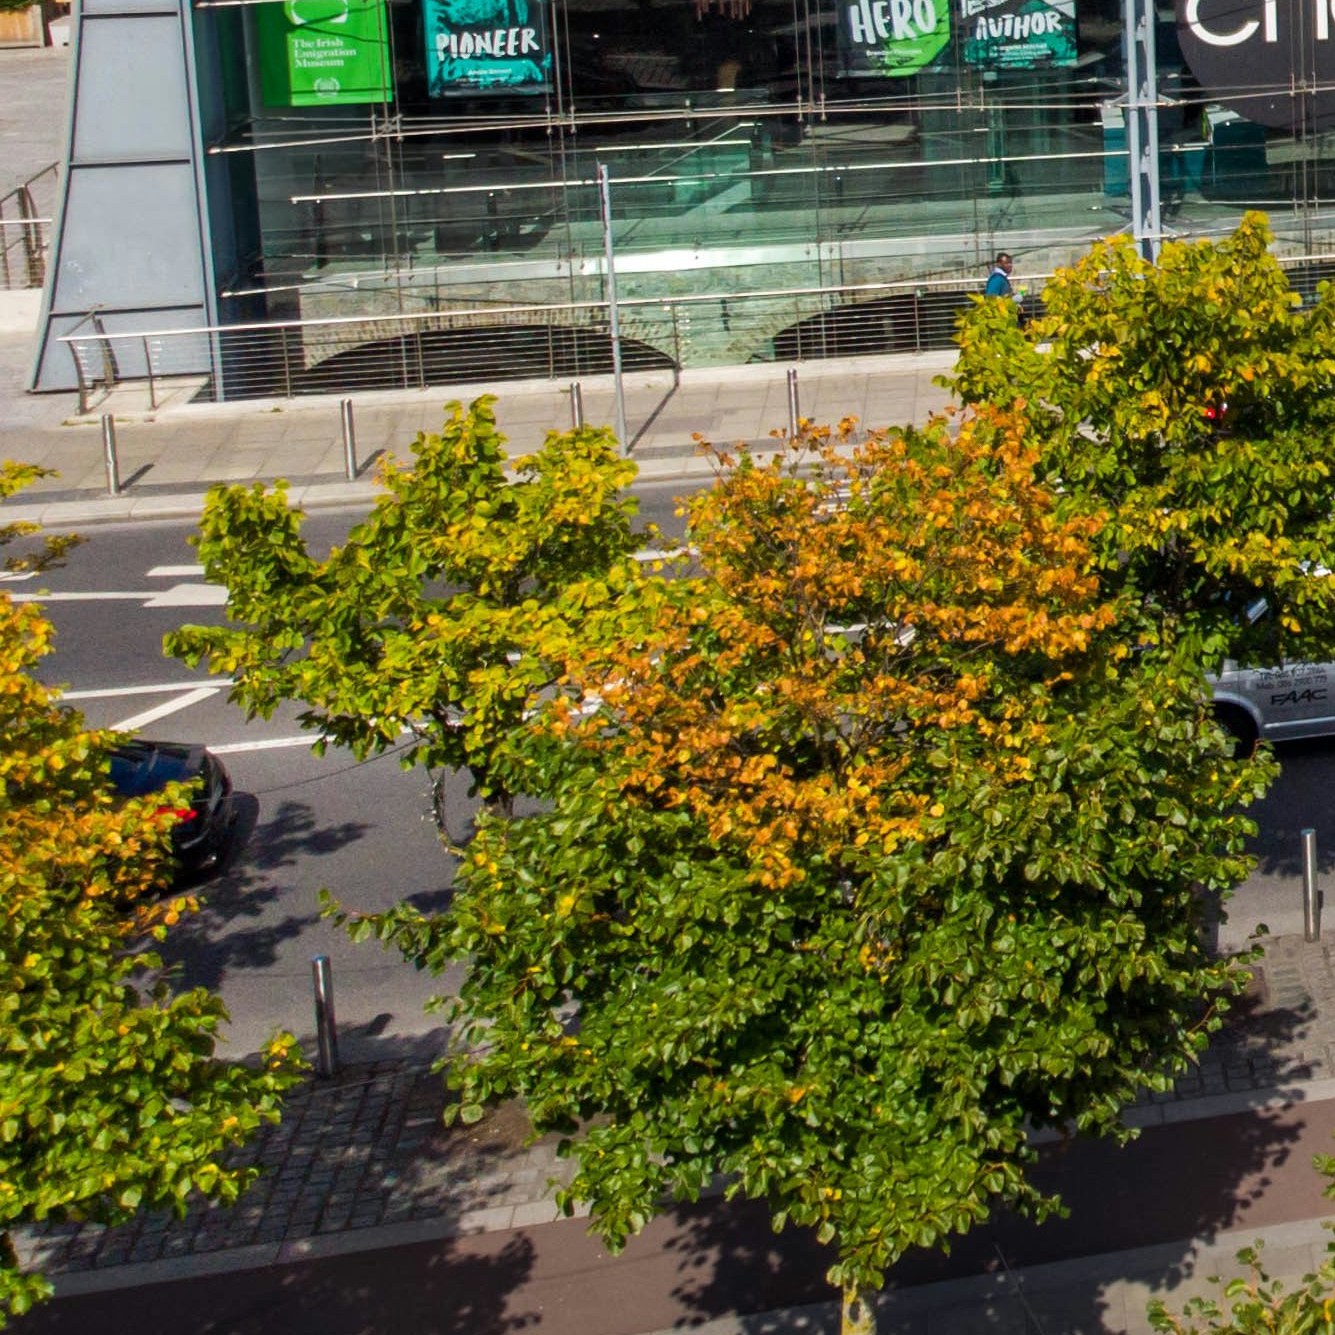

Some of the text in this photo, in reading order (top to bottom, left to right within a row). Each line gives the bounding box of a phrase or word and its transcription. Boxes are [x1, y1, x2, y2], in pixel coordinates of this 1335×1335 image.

[976, 11, 1063, 41] AUTHOR
[293, 37, 344, 48] The Irish
[436, 27, 540, 62] PIONEER
[293, 48, 357, 60] Emigration
[295, 58, 345, 68] Museum
[1271, 688, 1328, 705] FAAC
